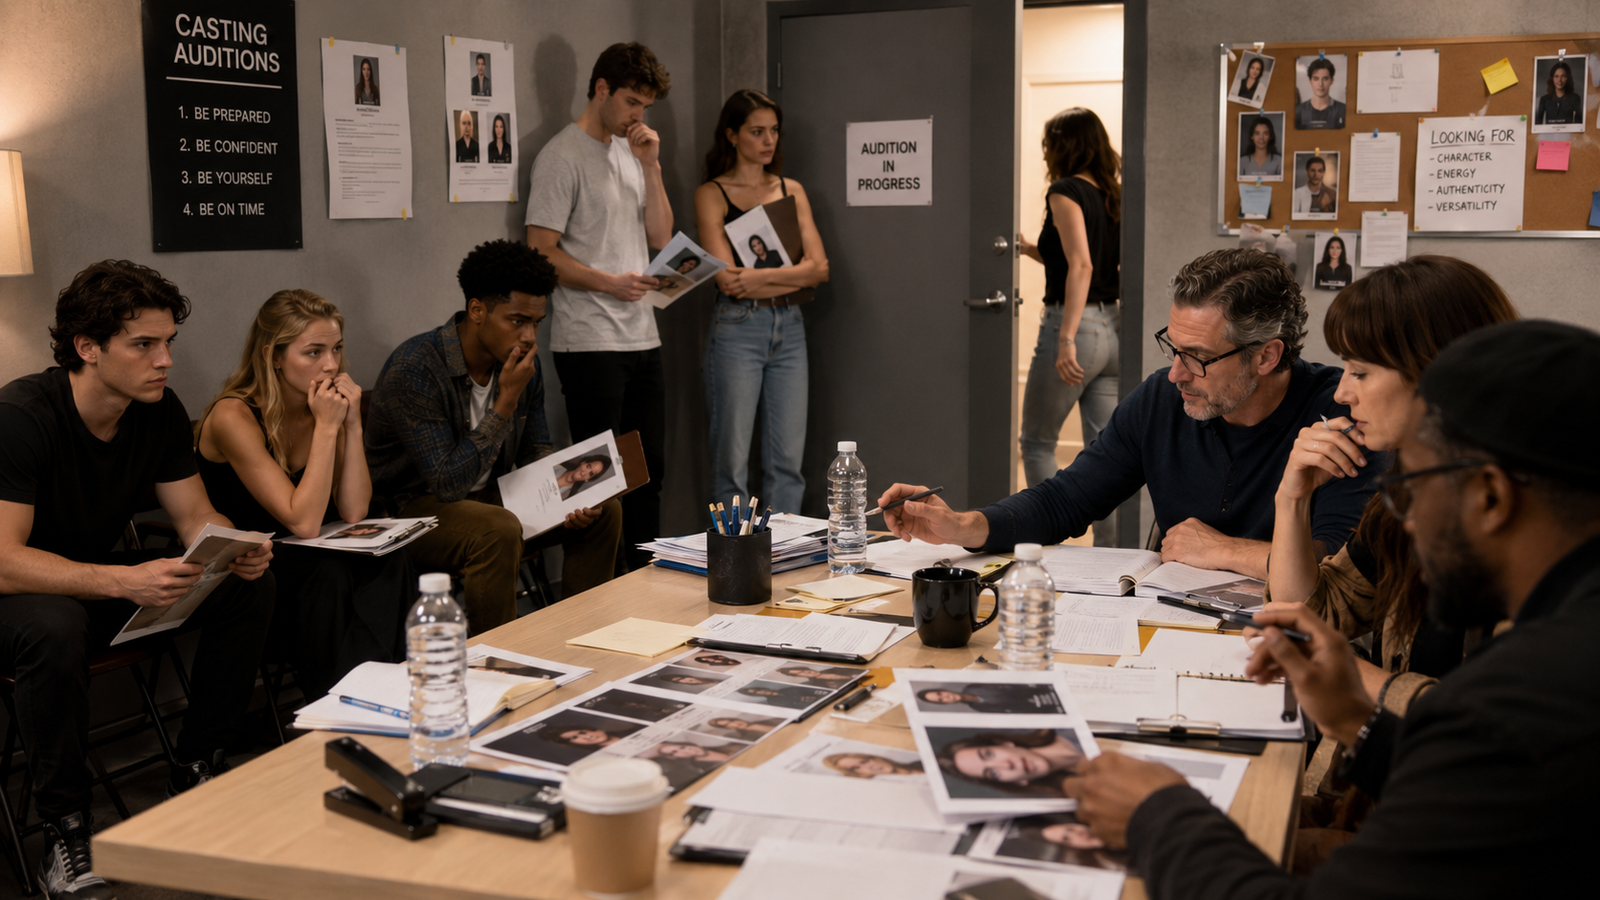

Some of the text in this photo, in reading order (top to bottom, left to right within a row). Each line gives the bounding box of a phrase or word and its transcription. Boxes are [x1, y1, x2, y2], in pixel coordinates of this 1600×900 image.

[175, 14, 268, 46] CASTING
[173, 42, 280, 72] AUDITIONS
[178, 106, 271, 123] 1. BE PREPARED
[1431, 129, 1515, 144] LOOKING FOR
[179, 138, 278, 154] 2. BE CONFIDENT
[861, 141, 917, 155] AUDITION
[1437, 152, 1493, 164] CHARACTER
[882, 160, 895, 173] IN
[181, 171, 273, 184] 3. BE YOURSELF
[1436, 169, 1476, 180] ENERGY
[858, 177, 921, 191] PROGRESS
[1436, 184, 1506, 196] AUTHENTICITY
[182, 203, 265, 215] 4. BE ON TIME
[1435, 201, 1498, 212] VERSATILITY
